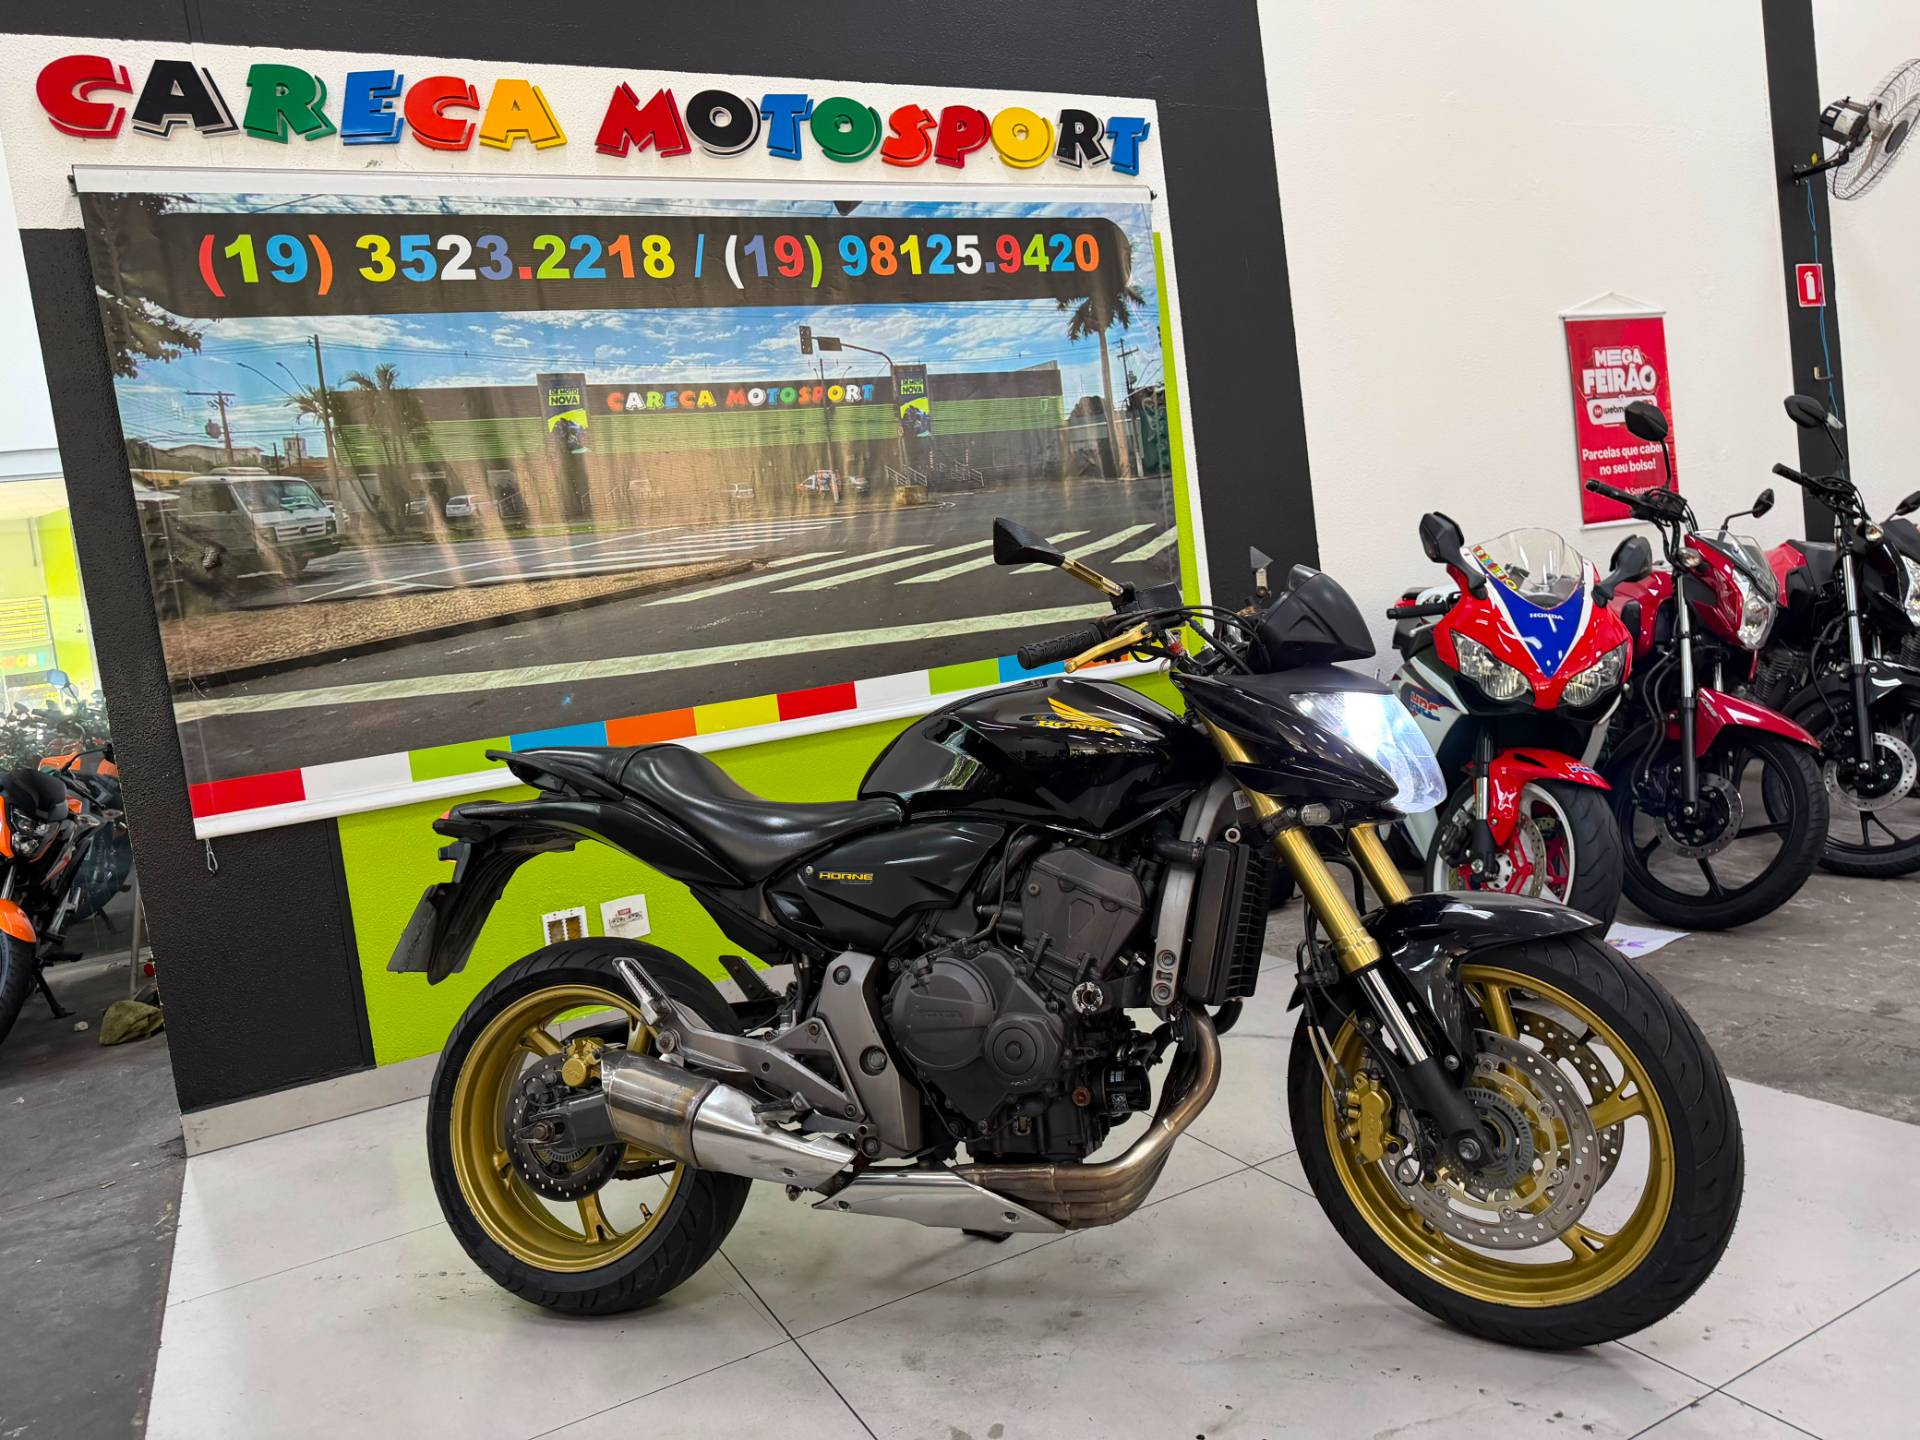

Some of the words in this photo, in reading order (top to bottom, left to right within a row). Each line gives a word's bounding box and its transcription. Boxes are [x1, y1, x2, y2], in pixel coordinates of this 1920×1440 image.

[36, 54, 568, 150] CARECA
[595, 82, 1151, 176] MOTOSPORT
[199, 234, 333, 297] (19)
[358, 234, 675, 283] 3523.2218
[694, 234, 705, 278] /
[725, 234, 823, 289] (19)
[840, 233, 1099, 277] 98125.9420
[1594, 348, 1642, 367] MEGA
[1583, 364, 1657, 395] FEIRÃO
[550, 396, 578, 405] NOVA
[607, 389, 717, 412] CARECA
[726, 384, 875, 408] MOTOSPORT
[1582, 446, 1621, 460] Parcelas
[1622, 446, 1639, 459] que
[1600, 466, 1612, 476] no
[1613, 464, 1628, 473] seu
[1629, 459, 1657, 472] bolso!
[1529, 612, 1564, 620] HONDA
[1039, 720, 1124, 737] HONDA
[819, 871, 874, 881] HORNE
